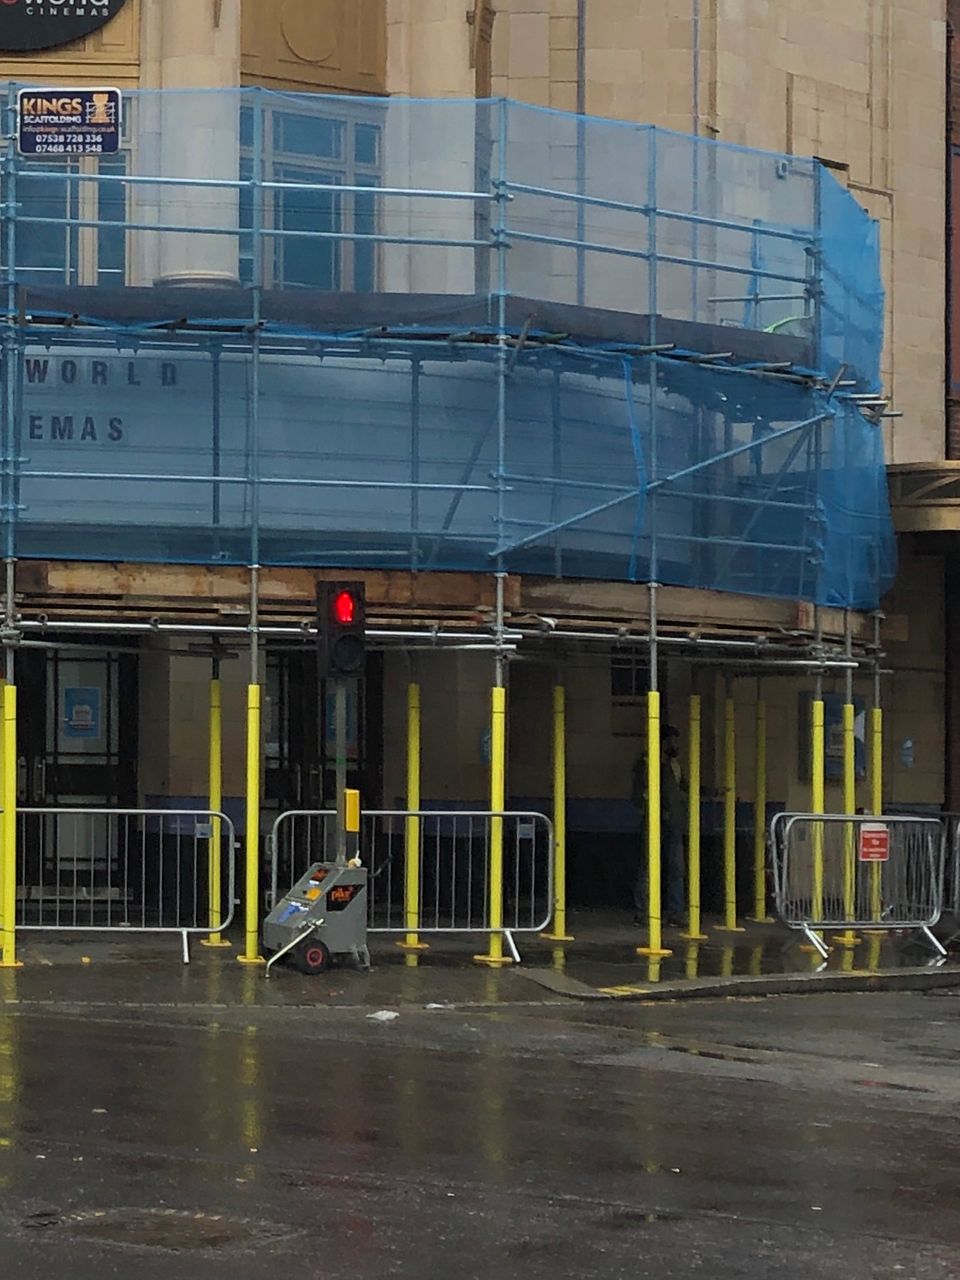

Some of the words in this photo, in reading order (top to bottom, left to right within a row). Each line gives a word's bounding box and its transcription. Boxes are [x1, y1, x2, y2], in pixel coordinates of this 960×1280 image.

[26, 6, 109, 17] CINEMAS
[23, 98, 82, 115] KINGS
[24, 116, 82, 124] SCAFFOLDING
